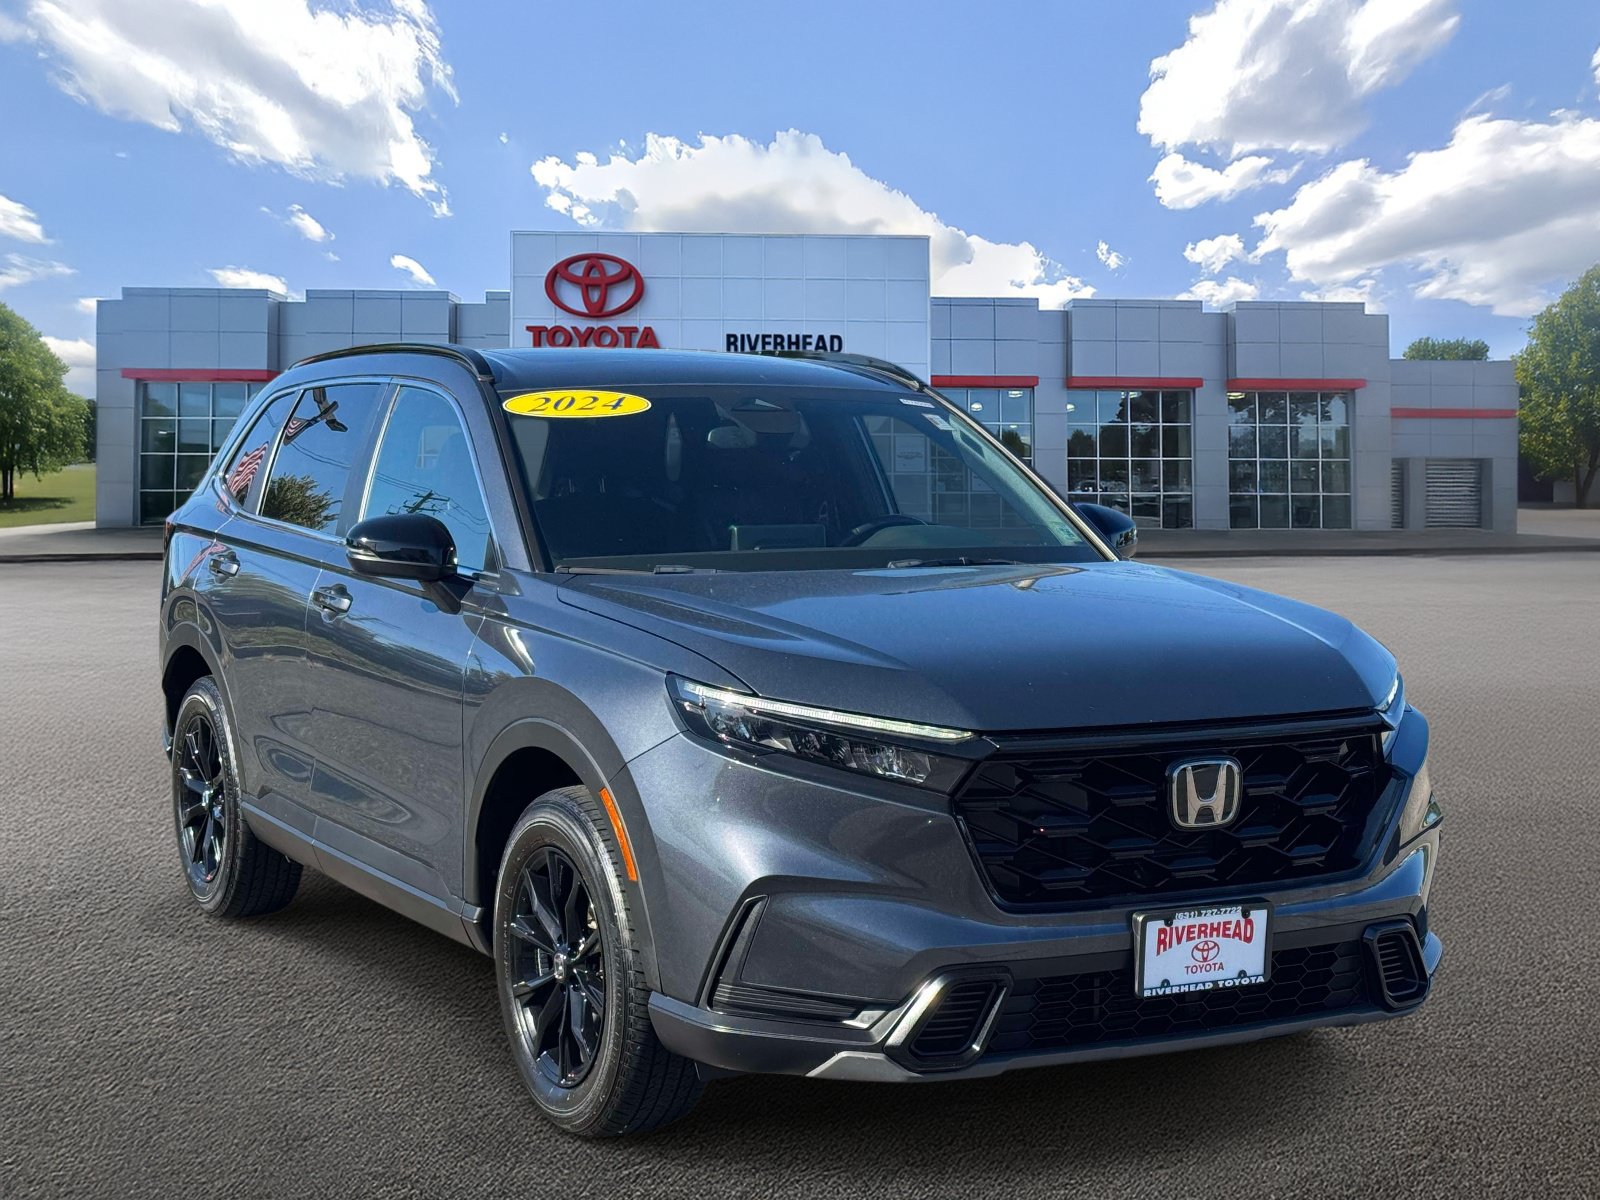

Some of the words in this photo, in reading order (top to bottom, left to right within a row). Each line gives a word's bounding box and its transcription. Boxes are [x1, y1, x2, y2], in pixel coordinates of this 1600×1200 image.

[526, 326, 660, 348] TOYOTA
[726, 334, 843, 352] RIVERHEAD
[527, 396, 625, 412] 2024
[1156, 918, 1254, 956] RIVERHEAD
[1184, 962, 1224, 975] TOYOTA
[1143, 982, 1213, 997] RIVERHEAD
[1218, 976, 1265, 988] TOYOTA
